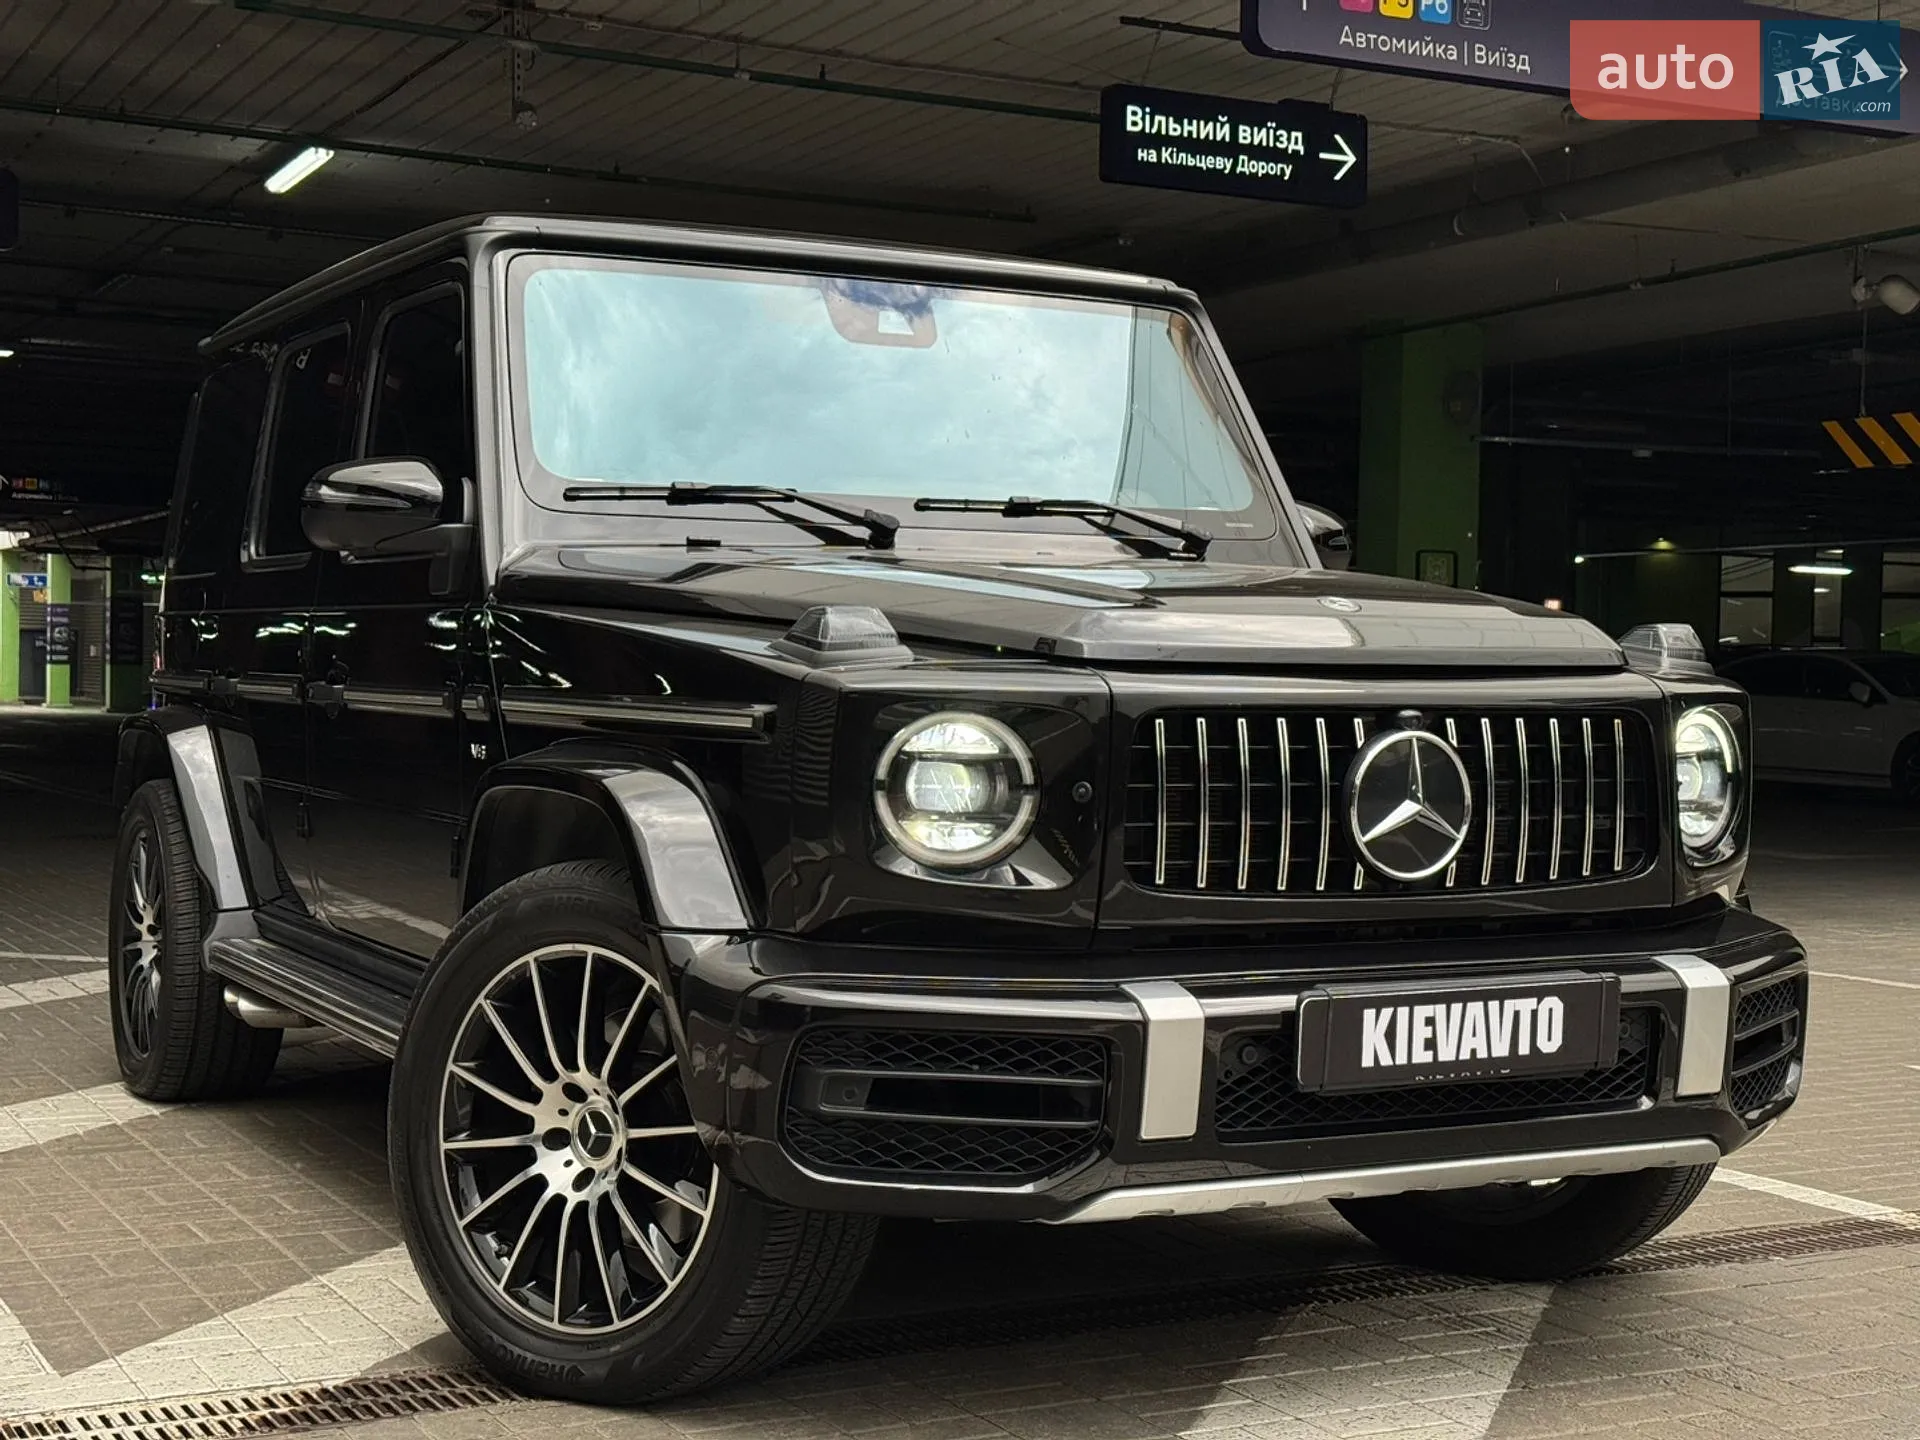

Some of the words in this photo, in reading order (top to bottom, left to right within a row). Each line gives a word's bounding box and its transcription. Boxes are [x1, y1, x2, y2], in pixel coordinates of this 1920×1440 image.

[1339, 25, 1457, 61] Автомийка
[1474, 43, 1531, 74] Виїзд
[1125, 104, 1231, 143] Вільний
[1237, 121, 1304, 155] виїзд
[1137, 147, 1157, 163] на
[1161, 147, 1233, 173] Кільцеву
[1236, 155, 1293, 180] Дорогу
[1361, 996, 1564, 1068] KIEVAVTO
